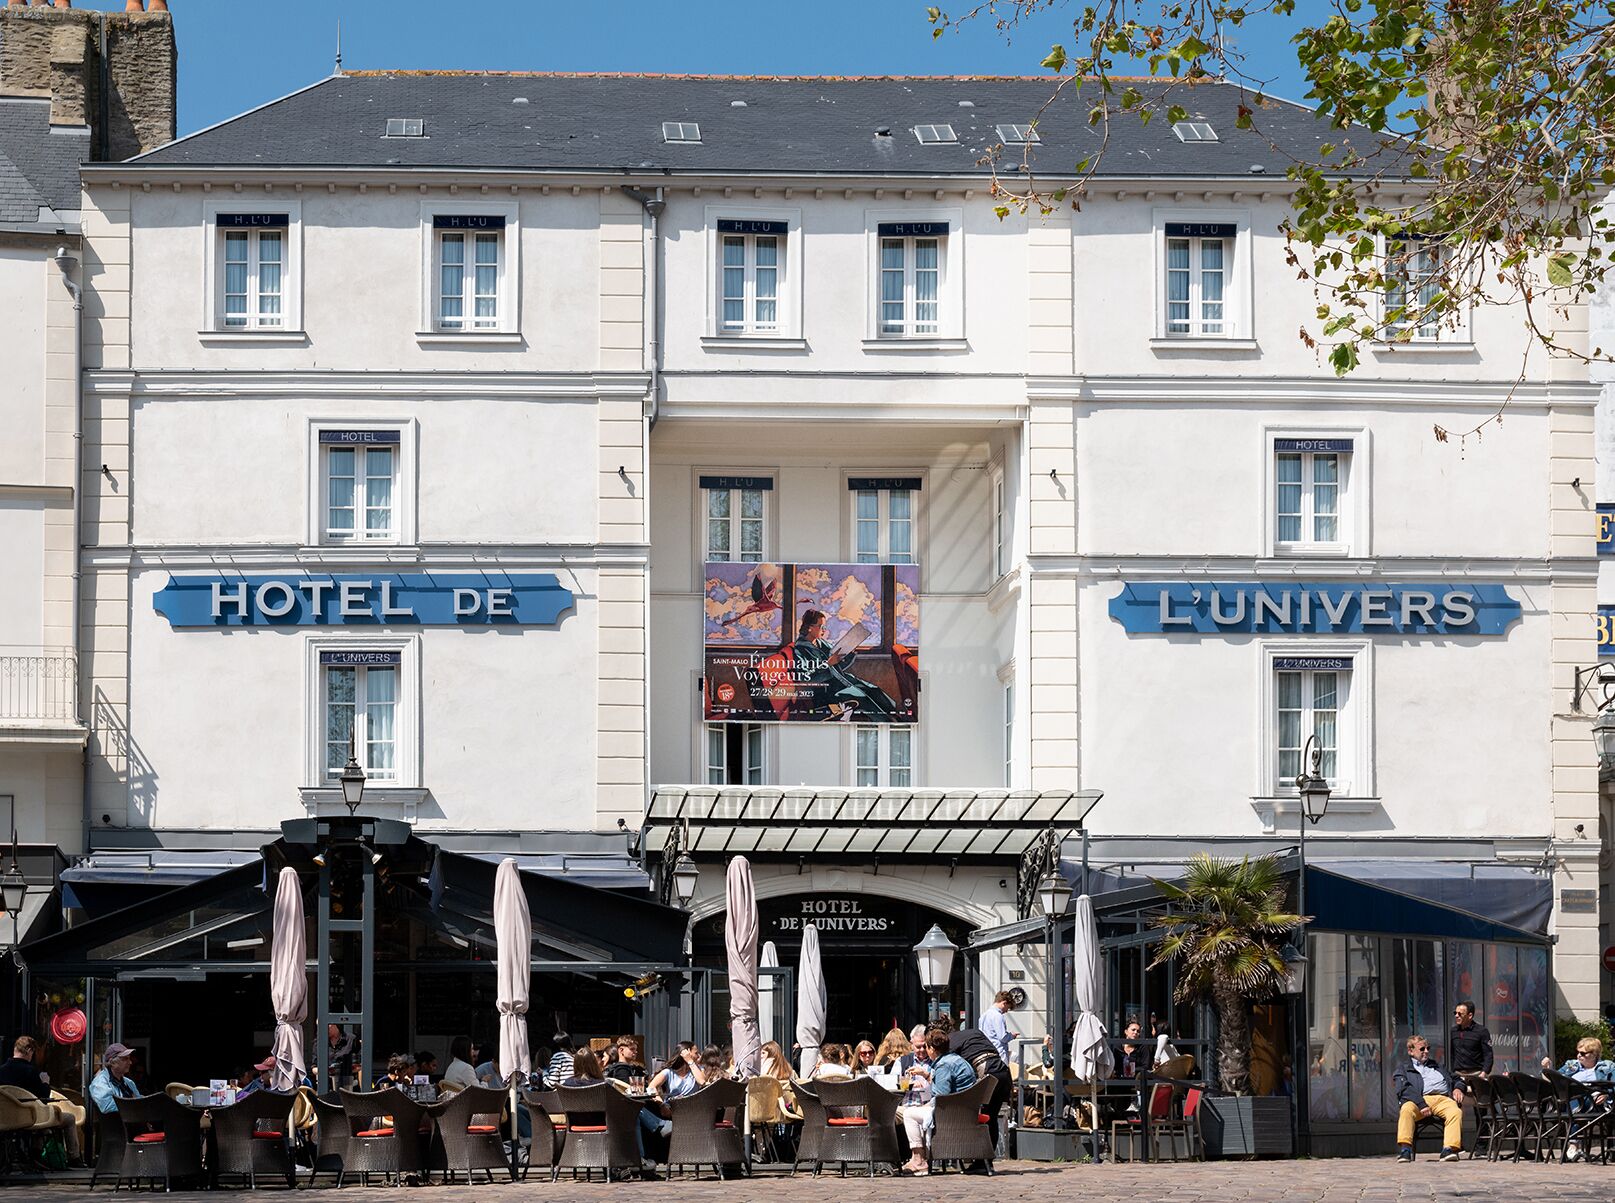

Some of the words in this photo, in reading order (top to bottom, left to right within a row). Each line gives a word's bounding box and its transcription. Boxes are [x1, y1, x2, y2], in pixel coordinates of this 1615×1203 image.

[341, 432, 377, 441] HOTEL
[1295, 440, 1331, 450] HOTEL
[209, 579, 414, 617] HOTEL
[452, 588, 514, 616] DE
[1159, 590, 1476, 627] L'UNIVERS
[331, 653, 391, 662] L'UNIVERS
[749, 650, 829, 669] Étonnants
[733, 666, 811, 686] Voyageurs
[801, 901, 862, 914] HOTEL
[780, 917, 799, 930] DE
